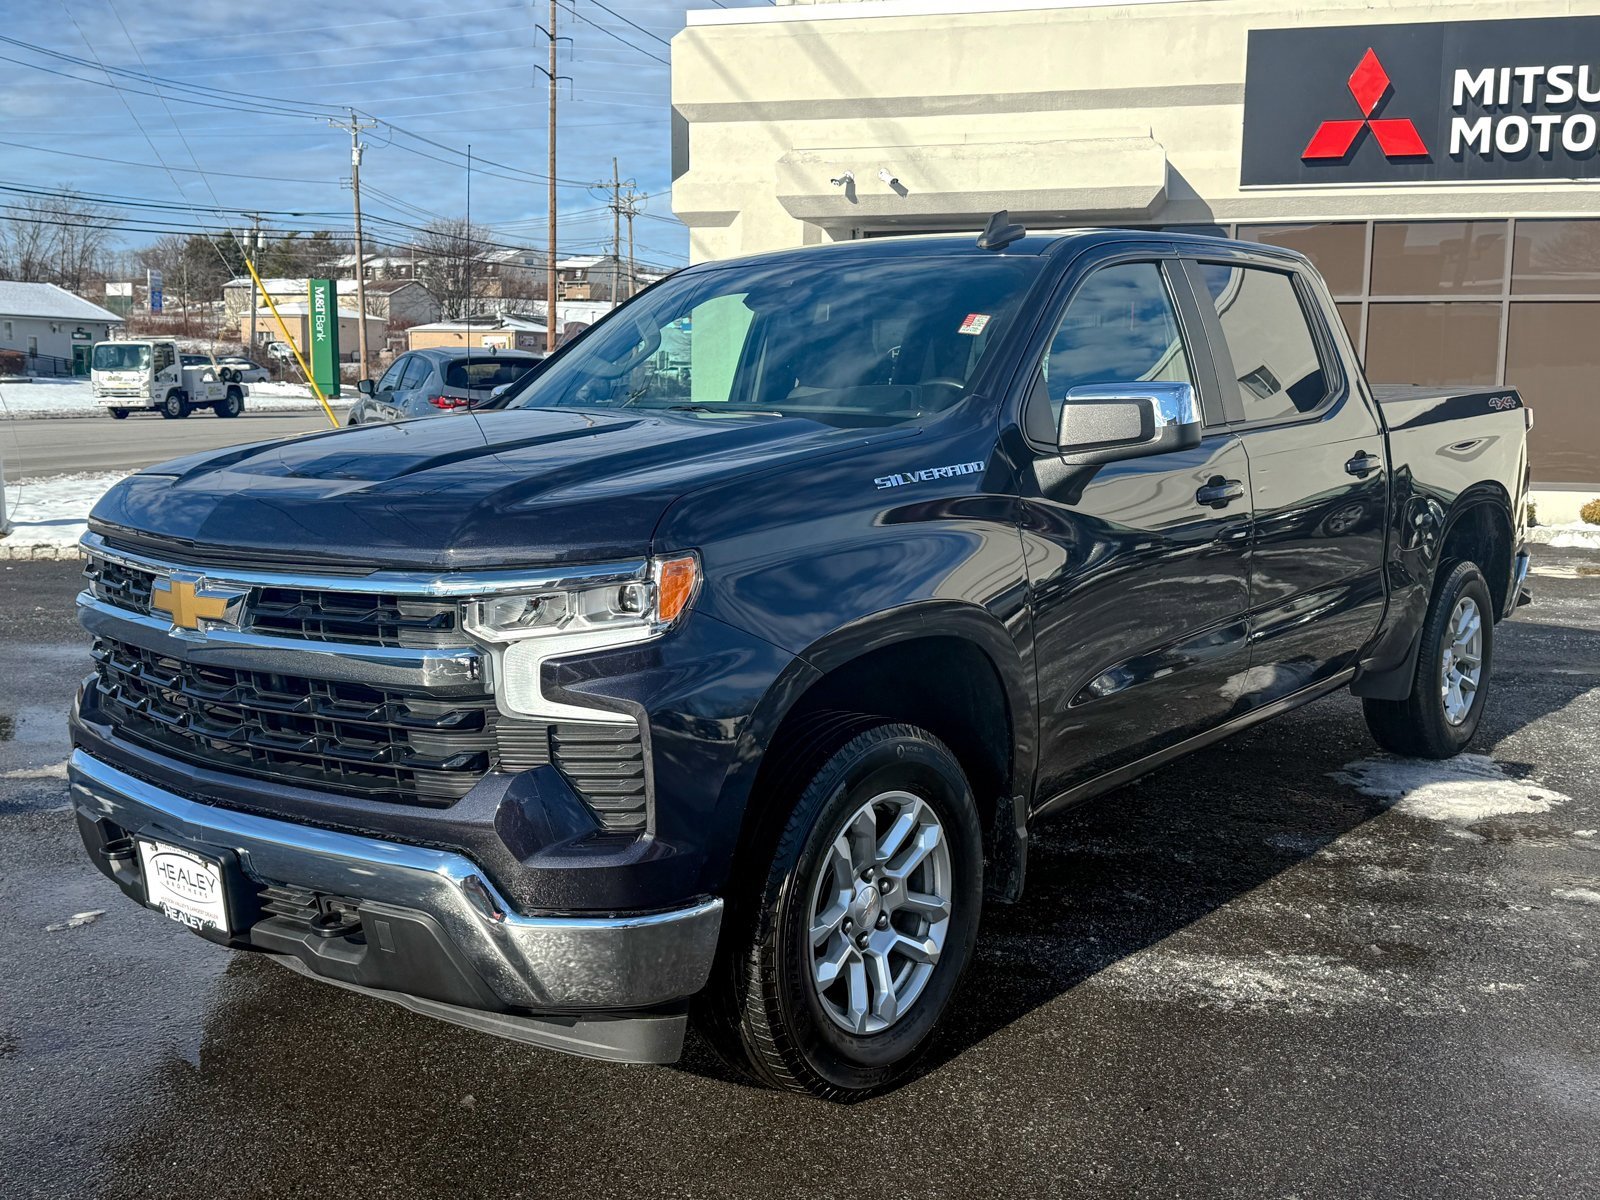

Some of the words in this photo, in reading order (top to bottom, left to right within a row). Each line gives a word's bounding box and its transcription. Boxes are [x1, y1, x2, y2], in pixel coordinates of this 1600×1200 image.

[1452, 65, 1600, 107] MITSU
[314, 286, 326, 315] M&T
[315, 314, 327, 342] Bank
[873, 460, 985, 490] SILVERADO
[155, 860, 215, 893] HEALEY
[166, 880, 208, 899] BROTHERS
[164, 904, 204, 931] HEALEY
